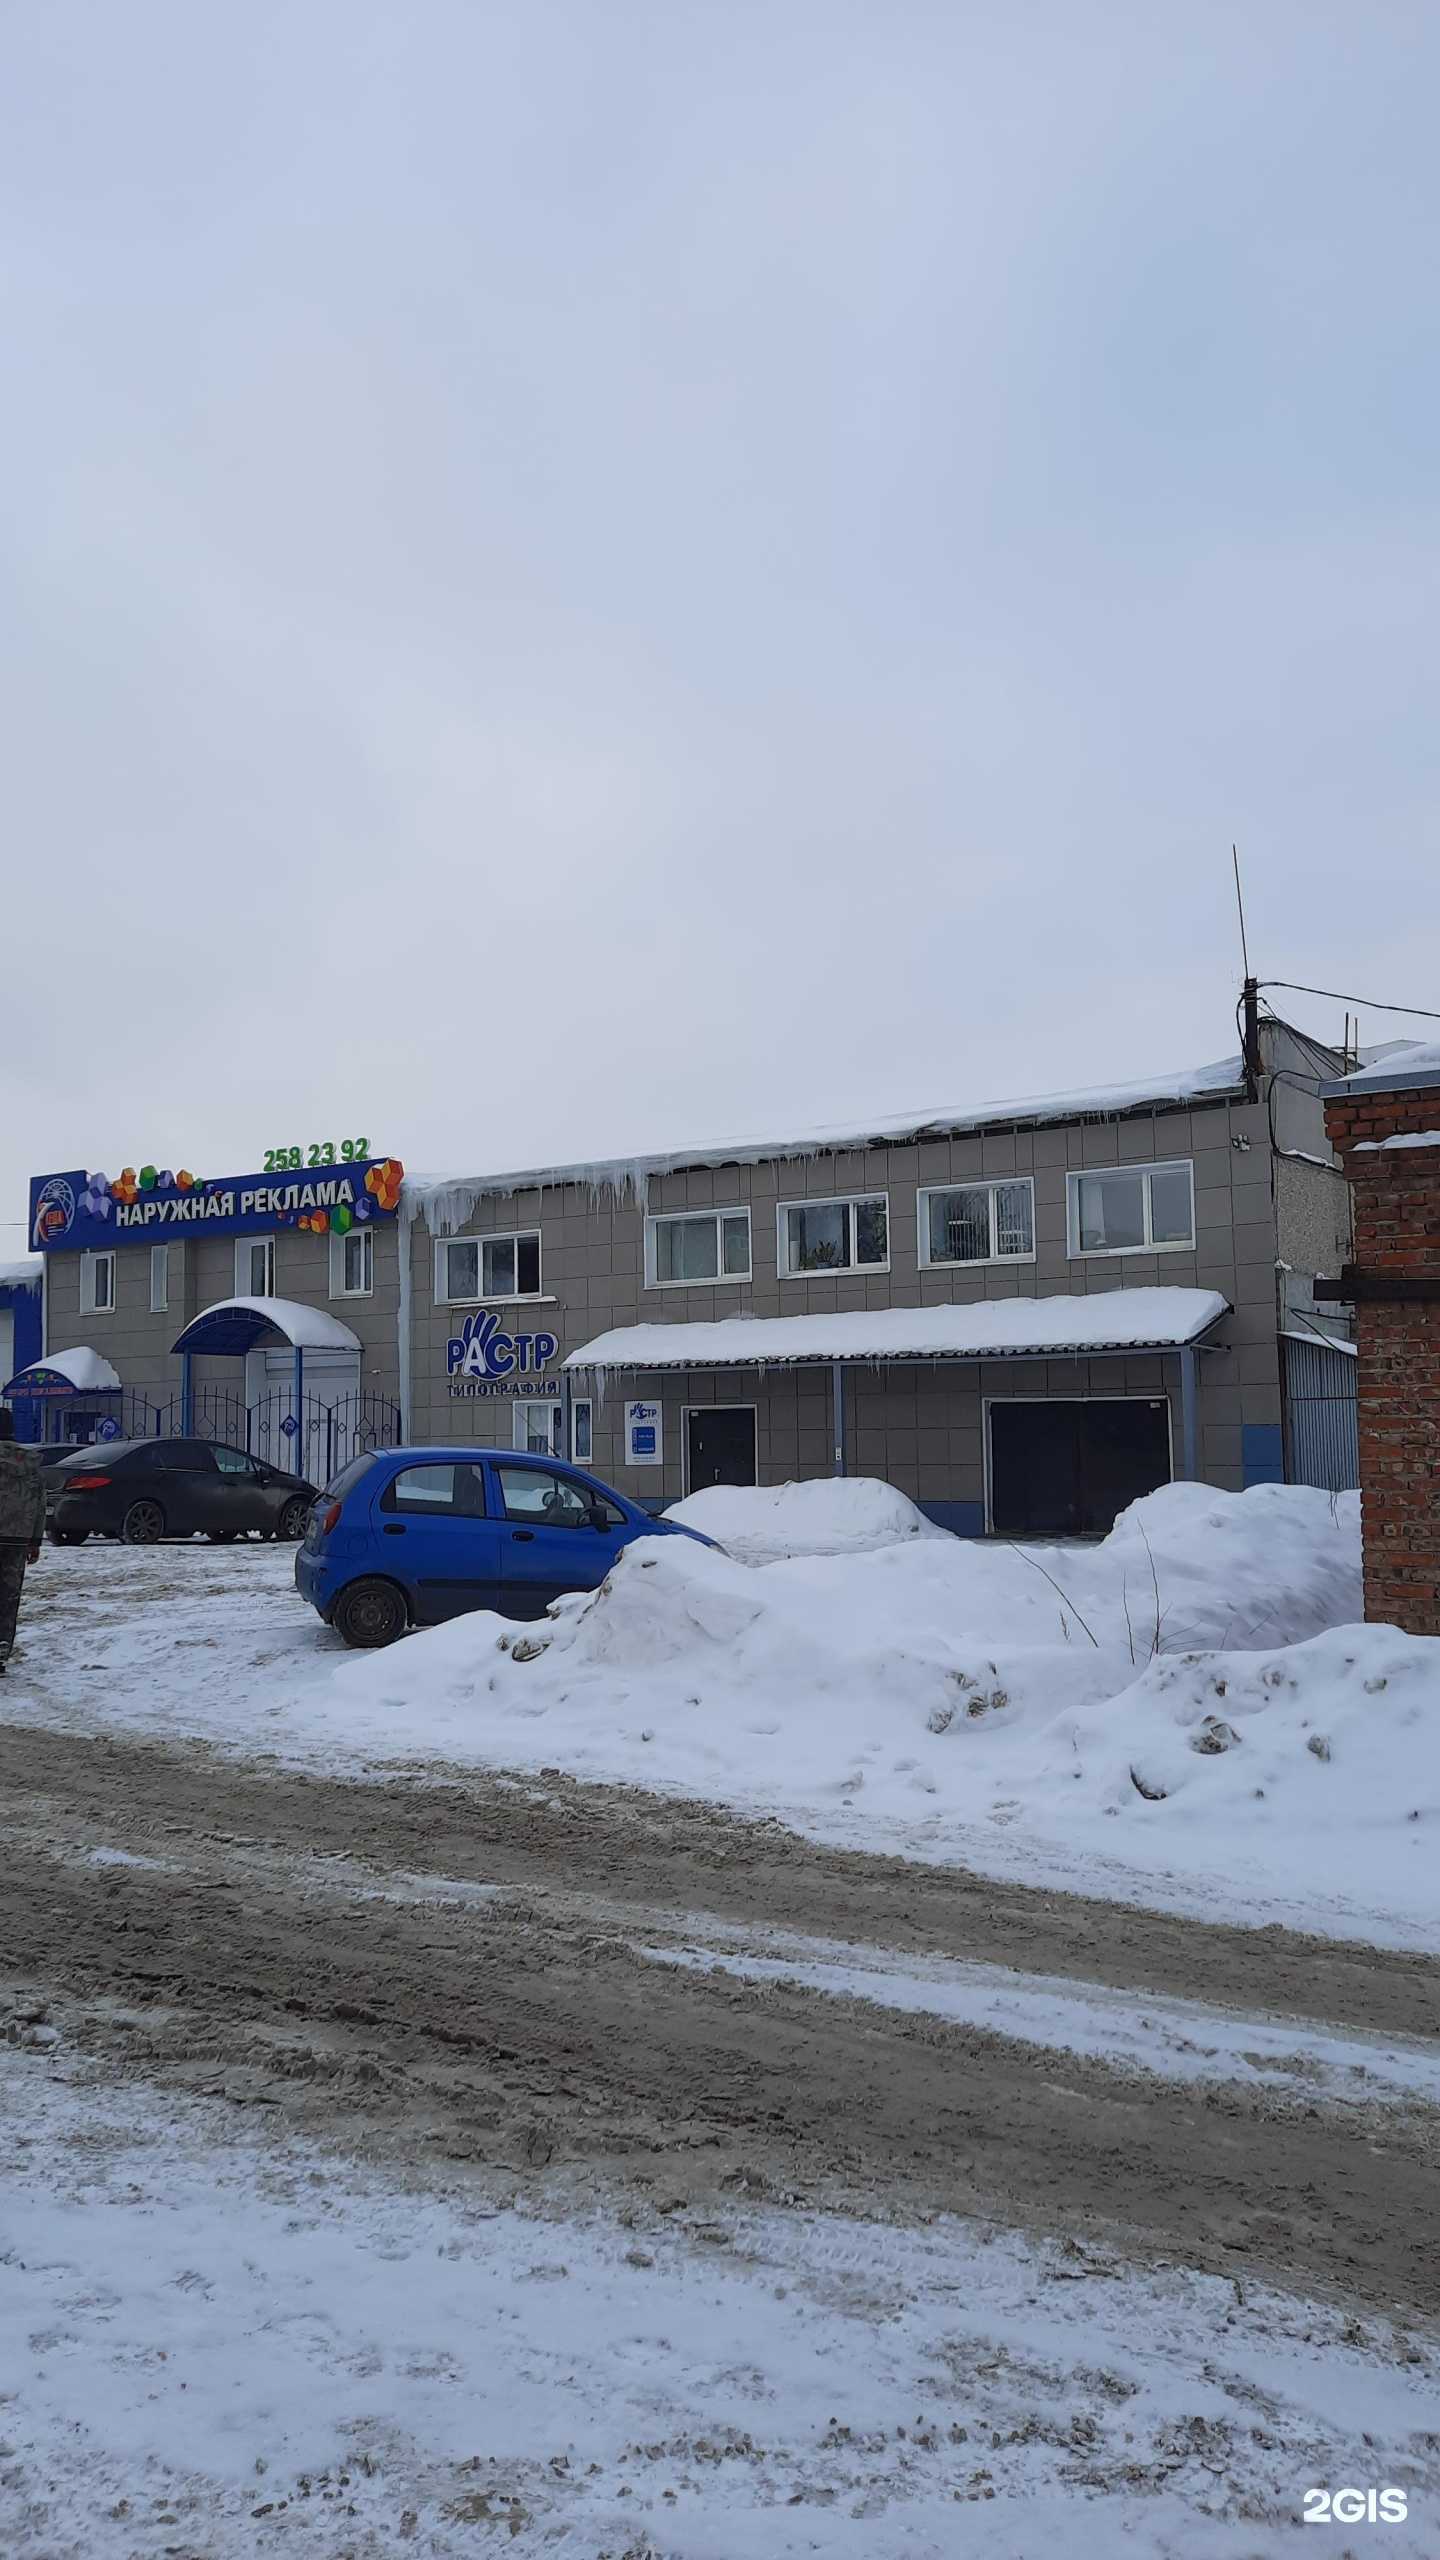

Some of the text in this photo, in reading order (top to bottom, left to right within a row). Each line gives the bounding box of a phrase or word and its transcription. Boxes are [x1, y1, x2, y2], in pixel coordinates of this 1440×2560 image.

[263, 1137, 370, 1172] 258 23 92
[116, 1178, 354, 1227] НАРУЖНАЯ РЕКЛАМА
[447, 1328, 559, 1381] РАСТР
[447, 1381, 560, 1397] ТИПОГРАФИЯ
